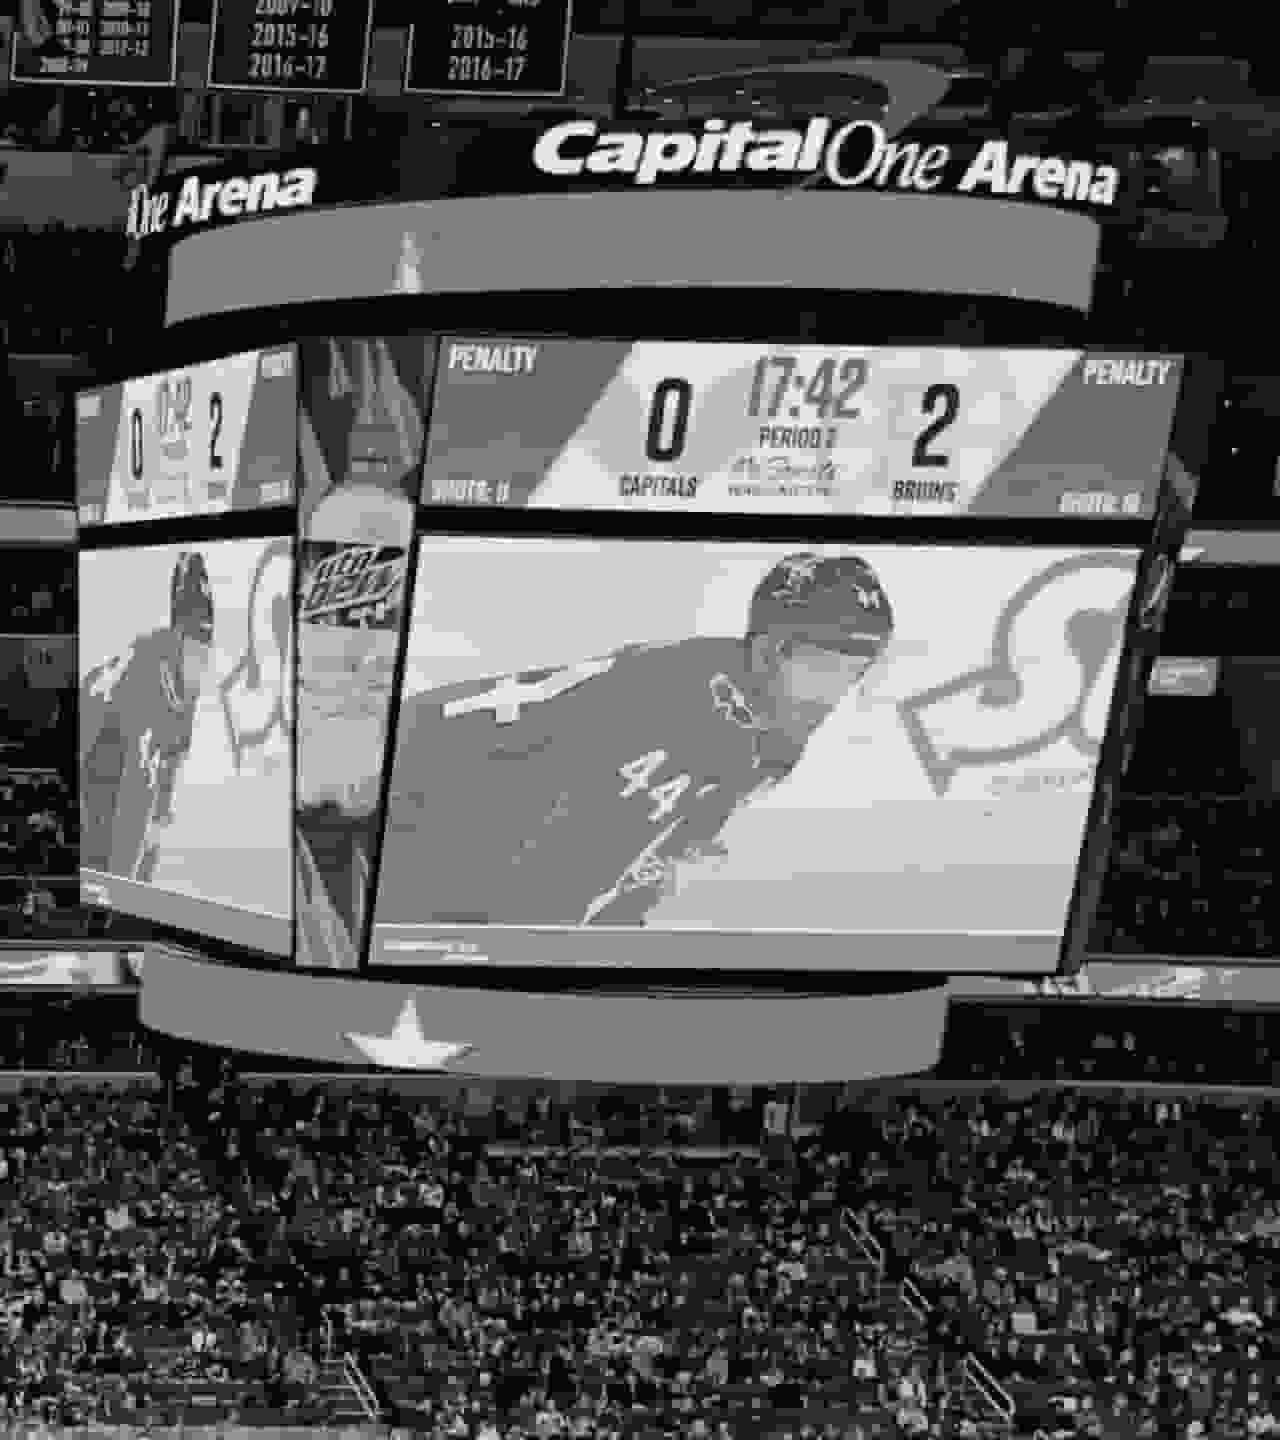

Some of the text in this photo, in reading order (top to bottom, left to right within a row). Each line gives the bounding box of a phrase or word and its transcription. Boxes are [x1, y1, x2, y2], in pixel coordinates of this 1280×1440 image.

[248, 23, 328, 48] 2015-16
[248, 52, 327, 80] 2016-17
[449, 23, 529, 48] 2015-16
[447, 54, 529, 81] 2016-17
[532, 115, 1121, 207] Capital One Arena
[171, 167, 319, 229] Arena
[447, 345, 538, 374] PENALTY
[746, 354, 872, 421] 17:42
[1081, 358, 1175, 386] PENALTY
[130, 407, 144, 481] 0
[207, 390, 224, 470] 2
[645, 377, 696, 464] 0
[913, 383, 959, 469] 2
